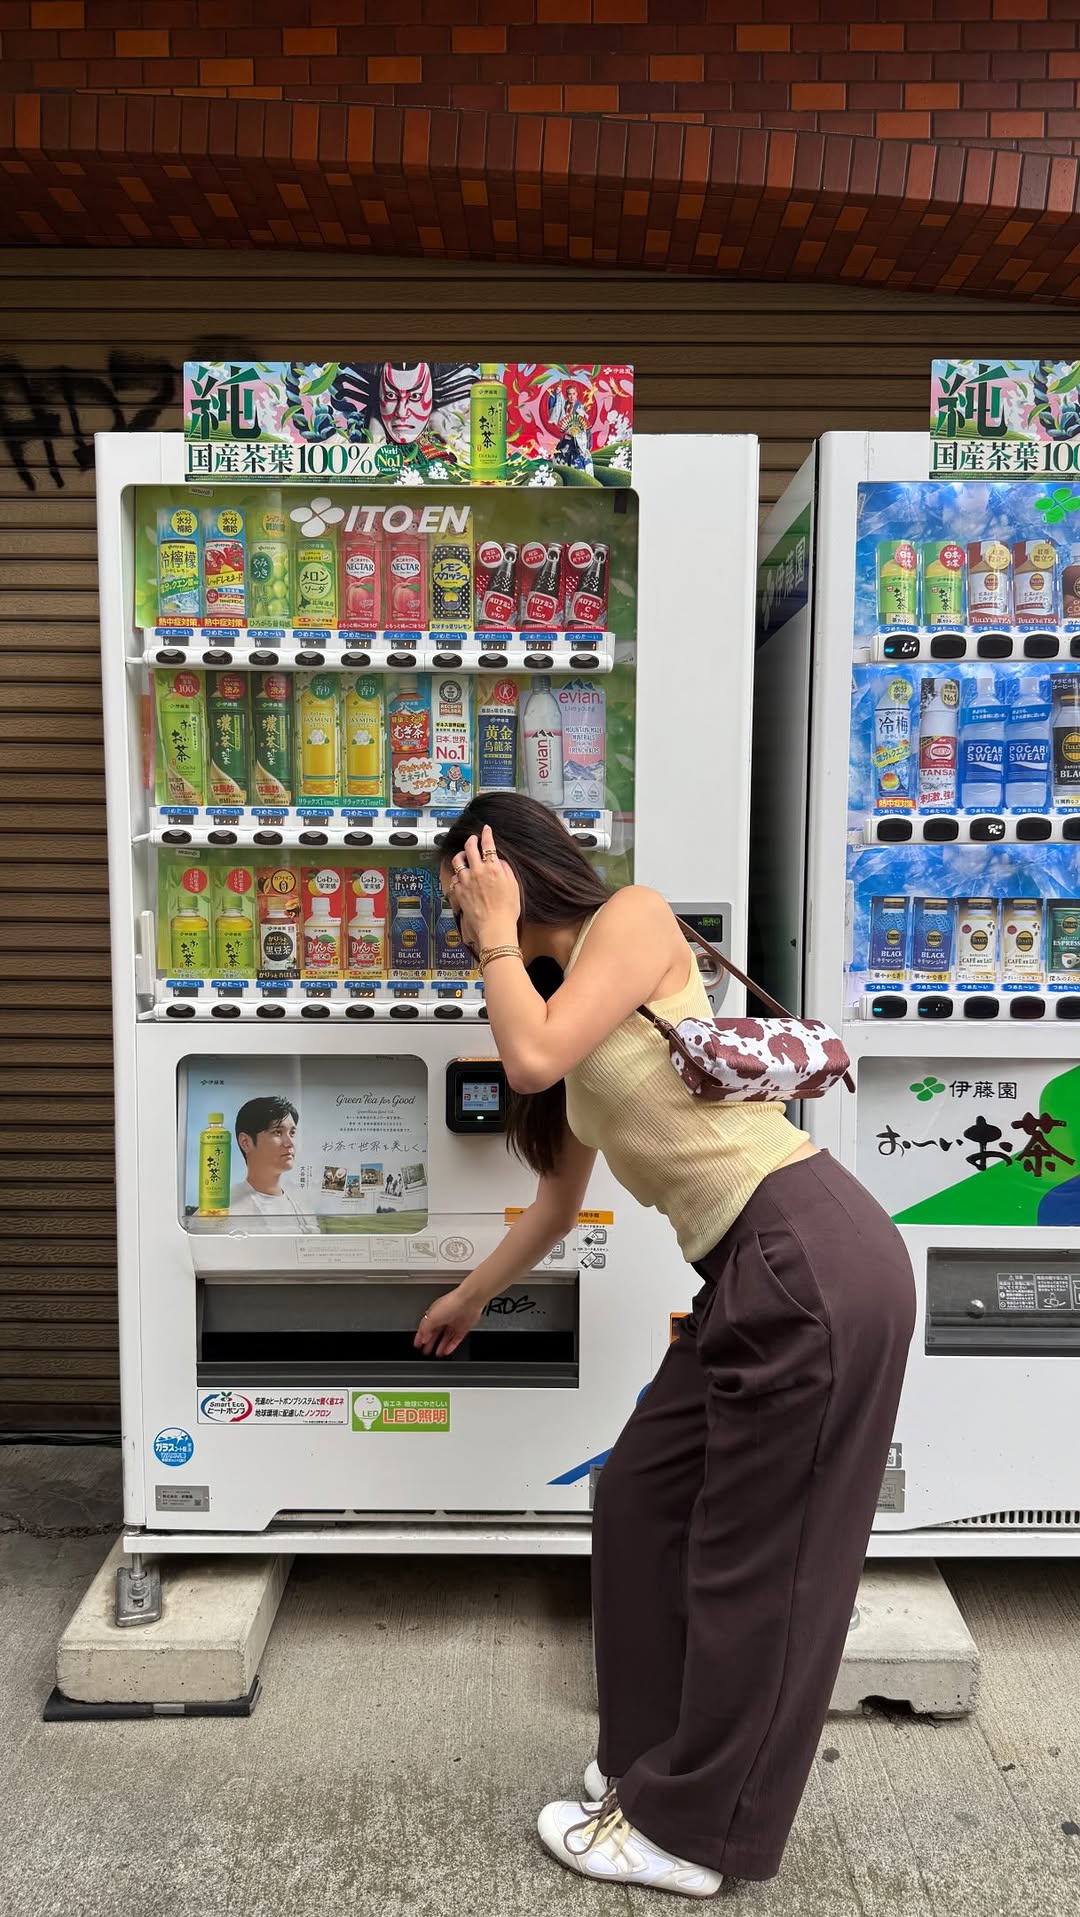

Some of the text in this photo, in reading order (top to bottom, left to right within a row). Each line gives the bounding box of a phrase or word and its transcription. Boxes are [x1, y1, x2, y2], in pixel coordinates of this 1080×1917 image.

[190, 364, 261, 440] 純
[935, 364, 1009, 440] 純
[188, 442, 373, 475] 国産茶葉100%
[377, 454, 401, 467] No.1
[177, 517, 192, 525] 水分
[223, 517, 238, 525] 水分
[344, 505, 471, 533] ITO EN
[347, 563, 373, 572] NECTAR
[392, 563, 420, 572] NECTAR
[440, 562, 464, 573] レモン
[301, 570, 330, 582] メロン
[434, 572, 469, 582] スカッシュ
[304, 585, 326, 595] ソーダ
[488, 597, 512, 609] オロナミン
[531, 597, 554, 609] オロナミン
[577, 597, 600, 609] オロナミン
[558, 690, 601, 704] evian
[393, 723, 425, 740] むぎ茶
[879, 715, 909, 736] 冷梅
[483, 724, 514, 742] 黄金
[435, 744, 466, 760] No.1
[483, 741, 514, 753] 烏龍茶
[536, 738, 550, 779] evian
[967, 754, 1003, 762] SWEAT
[1009, 753, 1046, 762] SWEAT
[400, 770, 430, 784] ミネラル
[394, 882, 424, 891] 甘い香り
[265, 945, 292, 956] 黒豆茶
[307, 942, 337, 955] りんご
[351, 942, 381, 955] りんご
[881, 950, 903, 958] BLACK
[398, 951, 422, 959] BLACK
[442, 951, 466, 959] BLACK
[921, 951, 945, 959] BLACK
[948, 1080, 1018, 1100] 伊藤園
[335, 1093, 417, 1108] Green Tea for Good
[362, 1410, 379, 1418] LED
[383, 1409, 448, 1425] LED照明
